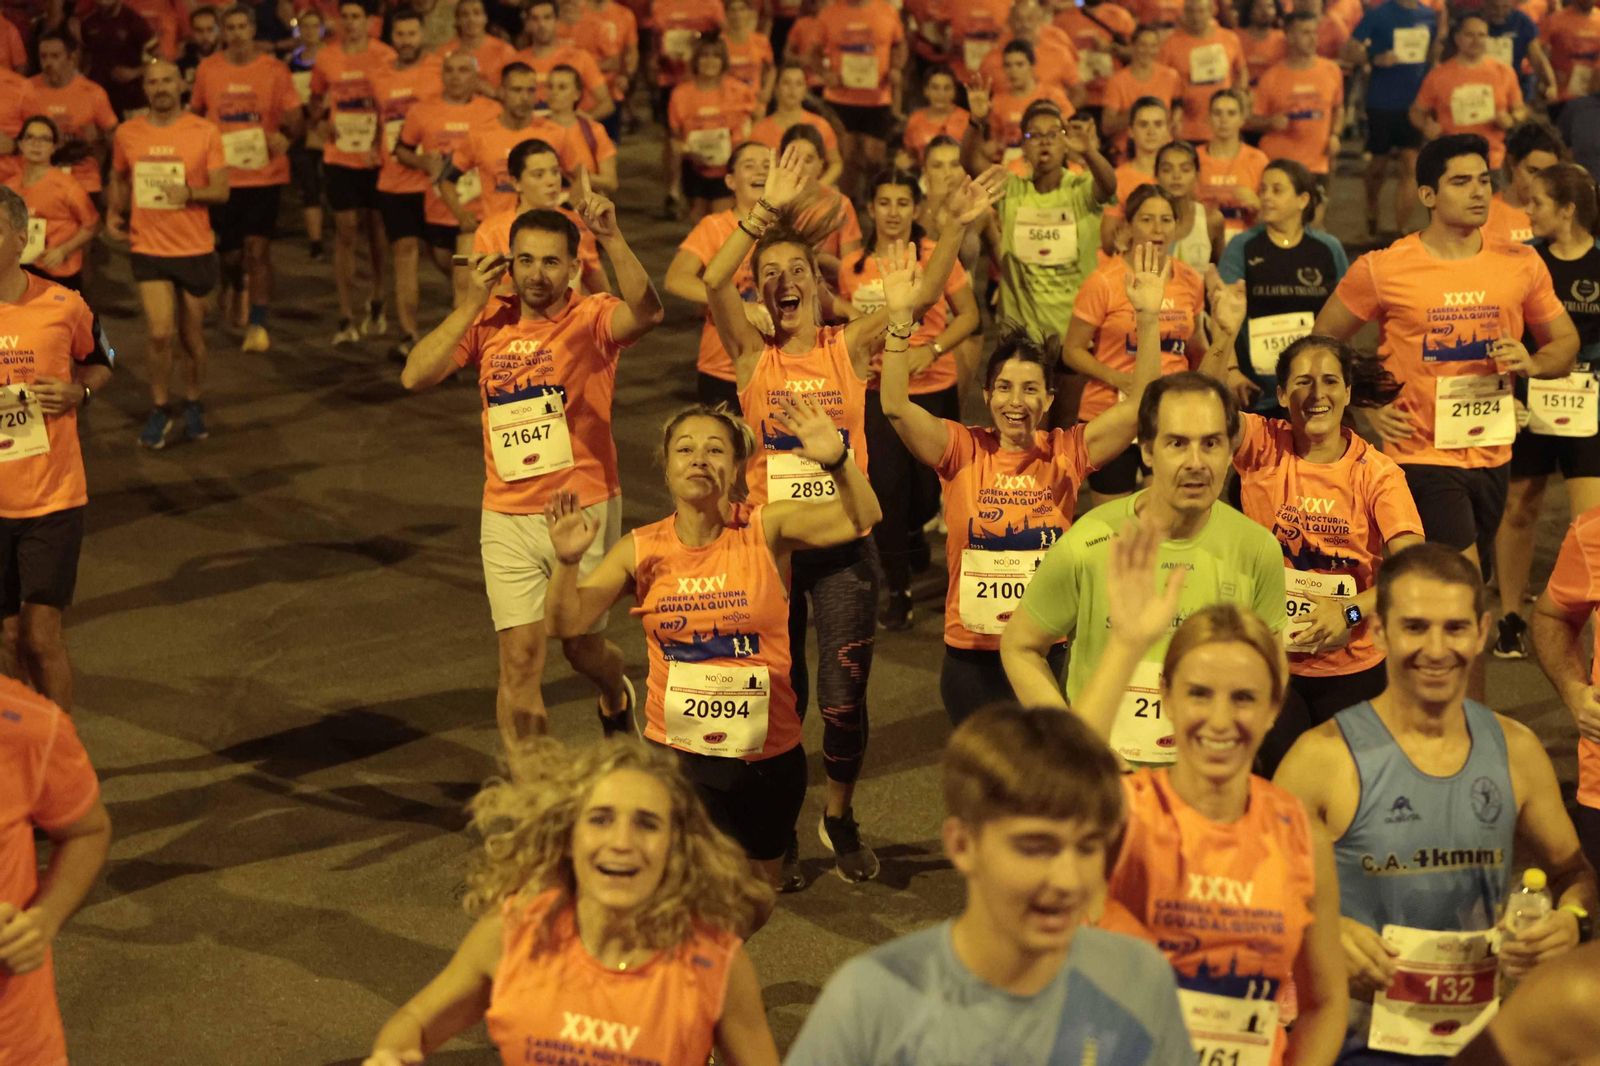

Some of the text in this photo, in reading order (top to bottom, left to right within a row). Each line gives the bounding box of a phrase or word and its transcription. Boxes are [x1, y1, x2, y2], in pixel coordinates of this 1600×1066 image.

[1029, 228, 1060, 240] 5646
[1443, 290, 1486, 307] XXXV
[1432, 311, 1500, 321] GUADALQUIVIR
[1263, 334, 1304, 350] 1510
[0, 356, 35, 364] QUIVIR
[490, 353, 522, 361] CARRERA
[784, 378, 826, 393] XXXV
[1452, 399, 1501, 417] 21824
[1542, 394, 1585, 408] 15112
[502, 424, 551, 448] 21647
[790, 480, 836, 499] 2893
[994, 473, 1037, 490] XXXV
[1305, 515, 1350, 526] NOCTURNA
[677, 573, 728, 594] XXXV
[976, 581, 1025, 599] 2100
[698, 590, 747, 600] NOCTURNA
[660, 598, 749, 613] GUADALQUIVIR
[682, 698, 750, 719] 20994
[1134, 698, 1161, 719] 21
[704, 734, 723, 742] KH7
[1362, 855, 1407, 872] C.A.
[1424, 975, 1476, 1002] 132
[558, 1010, 642, 1051] XXXV
